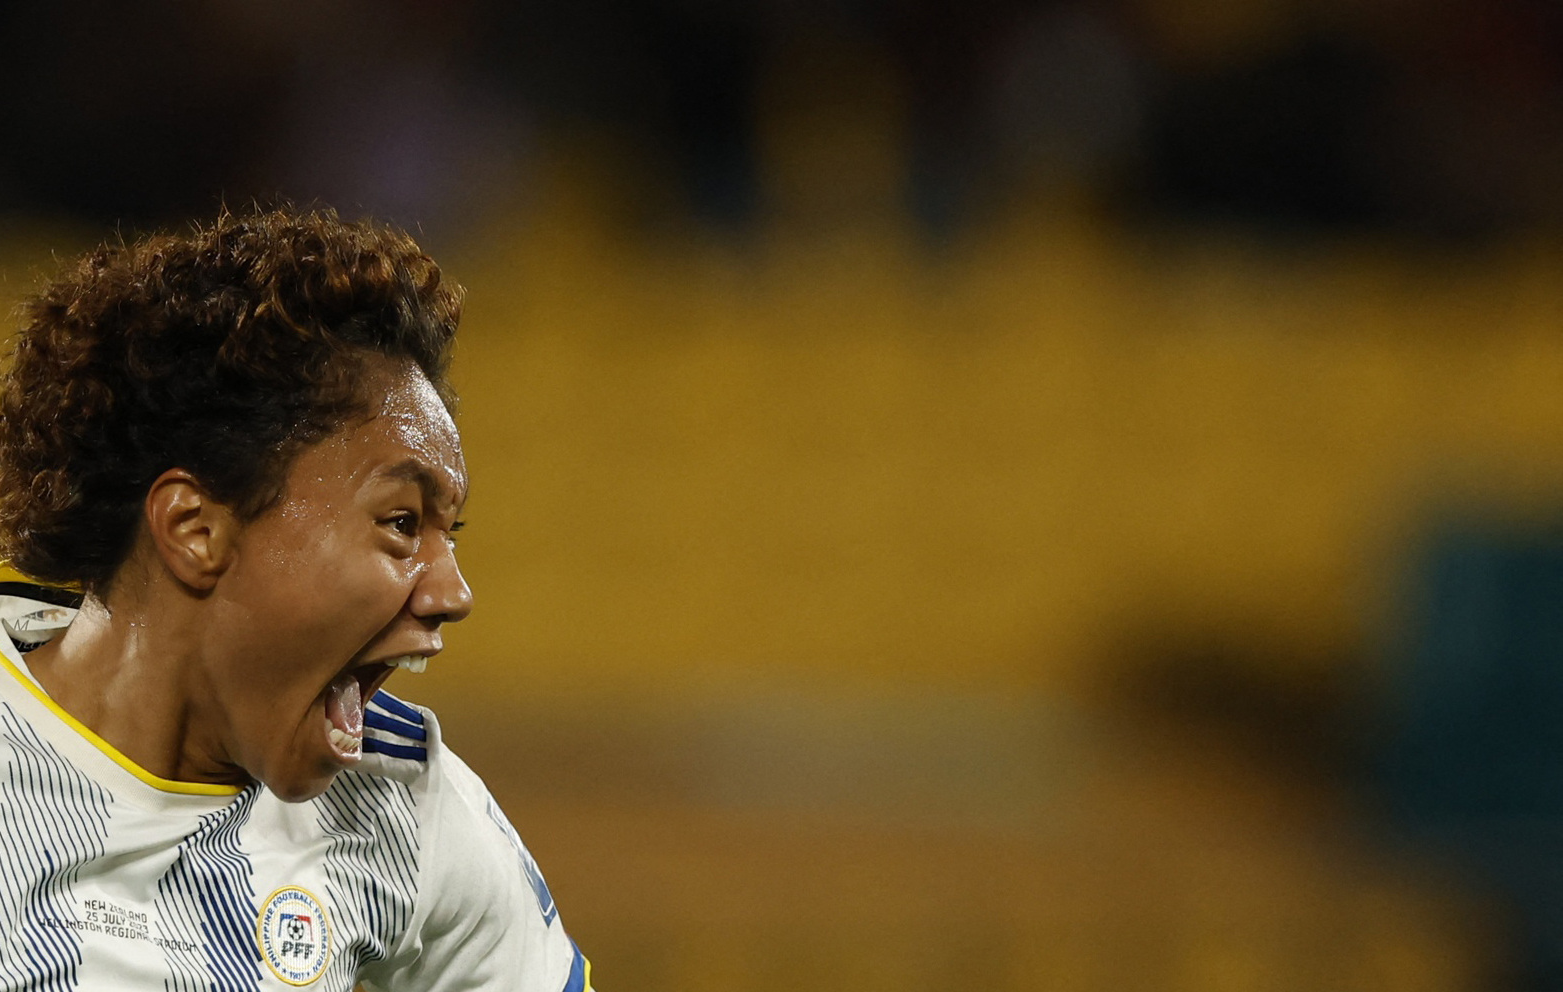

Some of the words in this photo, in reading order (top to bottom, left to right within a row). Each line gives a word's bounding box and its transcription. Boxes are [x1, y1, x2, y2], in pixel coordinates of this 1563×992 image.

[84, 899, 106, 910] NEW
[275, 892, 313, 908] FOOTBALL
[85, 911, 98, 922] 25
[102, 913, 126, 926] JULY
[37, 917, 103, 933] WELLINGTON
[105, 925, 153, 944] REGIONAL
[264, 908, 280, 968] PHILIPPINE
[281, 940, 315, 959] PFF
